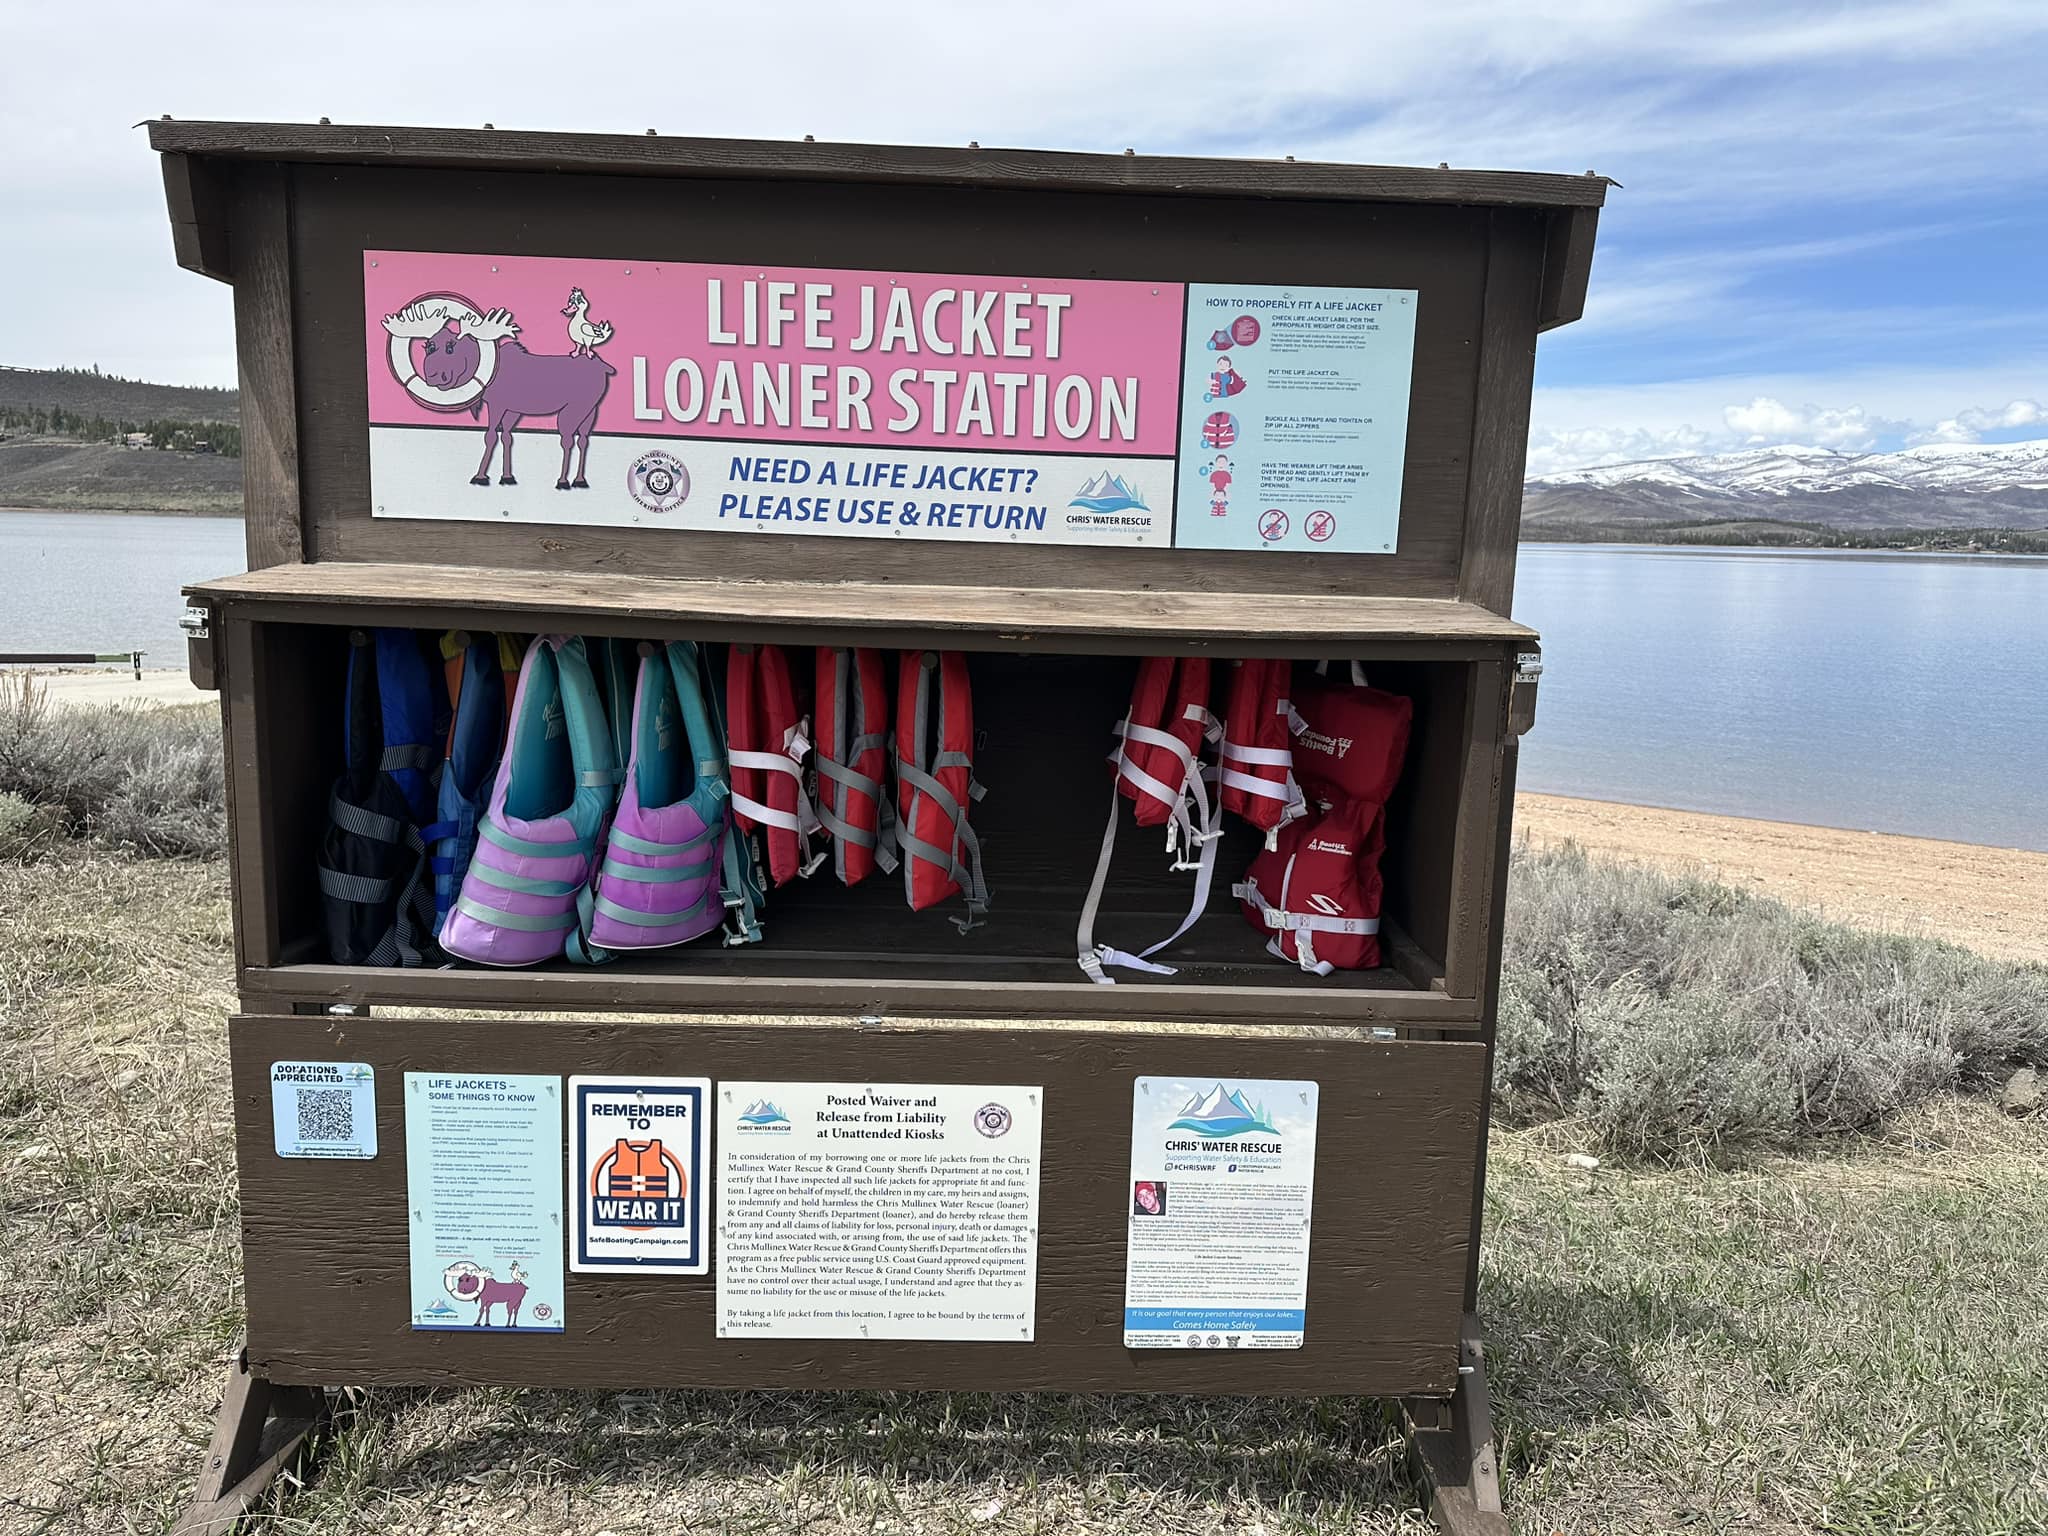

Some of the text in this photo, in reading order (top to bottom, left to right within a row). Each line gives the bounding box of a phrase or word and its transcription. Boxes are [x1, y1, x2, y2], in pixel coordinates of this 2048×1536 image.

[1206, 298, 1383, 311] HOW TO PROPERLY FIT A LIFE JACKET
[708, 279, 1072, 359] LIFE JACKET
[633, 356, 1136, 440] LOANER STATION
[729, 456, 1038, 493] NEED A LIFE JACKET?
[719, 493, 1047, 530] PLEASE USE & RETURN
[1065, 515, 1151, 526] CHRIS' WATER RESCUE
[1302, 729, 1337, 746] Founda
[272, 1073, 343, 1082] APPRECIATED
[428, 1079, 452, 1088] LIFE
[454, 1079, 506, 1090] JACKETS
[428, 1092, 535, 1102] SOME THINGS TO KNOW
[826, 1094, 936, 1106] Posted Waiver and
[591, 1103, 686, 1117] REMEMBER
[626, 1117, 650, 1129] TO
[815, 1111, 947, 1125] Release from Liability
[816, 1127, 944, 1139] at Unattended Kiosks
[1164, 1140, 1282, 1153] CHRIS' WATER RESCUE
[728, 1152, 736, 1160] In
[739, 1152, 795, 1160] consideration
[825, 1153, 868, 1163] borrowing
[924, 1154, 937, 1162] life
[940, 1154, 967, 1164] jackets
[969, 1155, 989, 1163] from
[992, 1155, 1005, 1163] the
[1007, 1155, 1030, 1163] Chris
[1165, 1153, 1201, 1162] Supporting
[1222, 1154, 1242, 1163] Safety
[1249, 1155, 1281, 1163] Education
[728, 1163, 764, 1171] Mullinex
[767, 1164, 791, 1172] Water
[794, 1164, 823, 1172] Rescue
[835, 1164, 862, 1172] Grand
[864, 1165, 895, 1175] County
[897, 1165, 927, 1173] Sheriffs
[930, 1166, 979, 1176] Department
[596, 1200, 680, 1220] WEAR IT
[588, 1236, 688, 1245] SafeBoatingCampaign.com
[727, 1309, 738, 1318] By
[739, 1309, 765, 1319] taking
[773, 1309, 786, 1317] life
[788, 1309, 811, 1319] jacket
[893, 1312, 915, 1320] agree
[938, 1311, 964, 1319] bound
[965, 1311, 976, 1320] by
[977, 1311, 990, 1319] the
[1156, 1310, 1171, 1318] goal
[727, 1319, 741, 1327] this
[1173, 1320, 1256, 1330] Comes Home Safely
